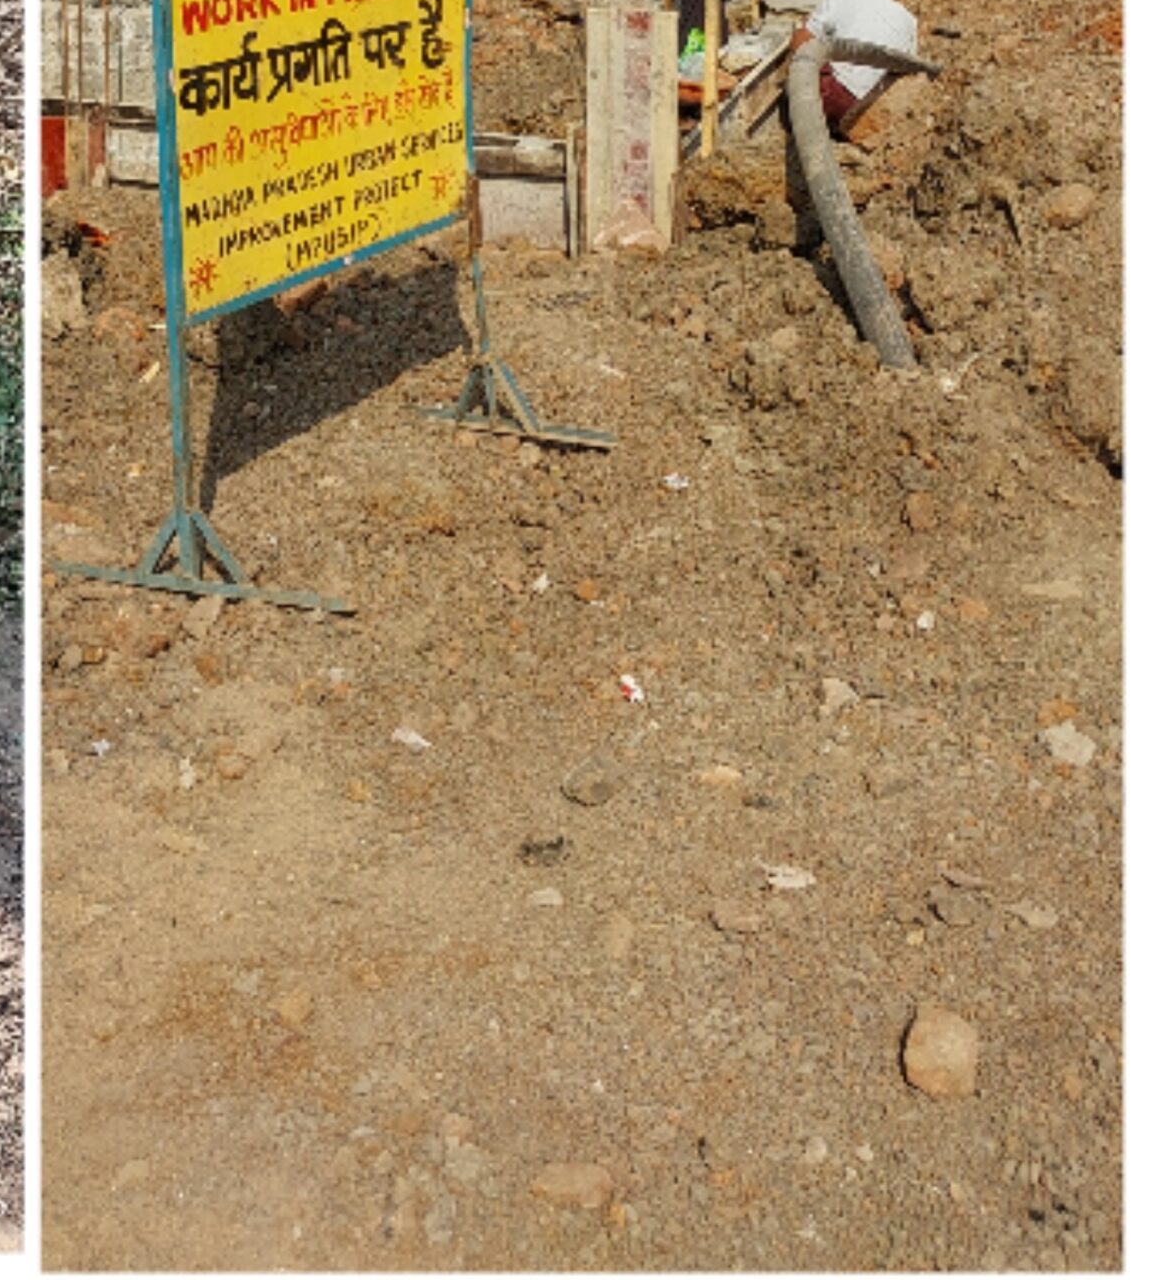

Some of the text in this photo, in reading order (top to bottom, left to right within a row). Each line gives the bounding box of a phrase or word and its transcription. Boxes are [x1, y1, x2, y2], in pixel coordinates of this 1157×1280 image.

[179, 31, 262, 116] कार्य
[265, 18, 353, 103] प्रगति
[359, 21, 412, 70] पर
[218, 168, 423, 258] IMPROVEMENT PROJECT
[262, 160, 340, 204] PRADESH
[344, 137, 396, 178] URBAN
